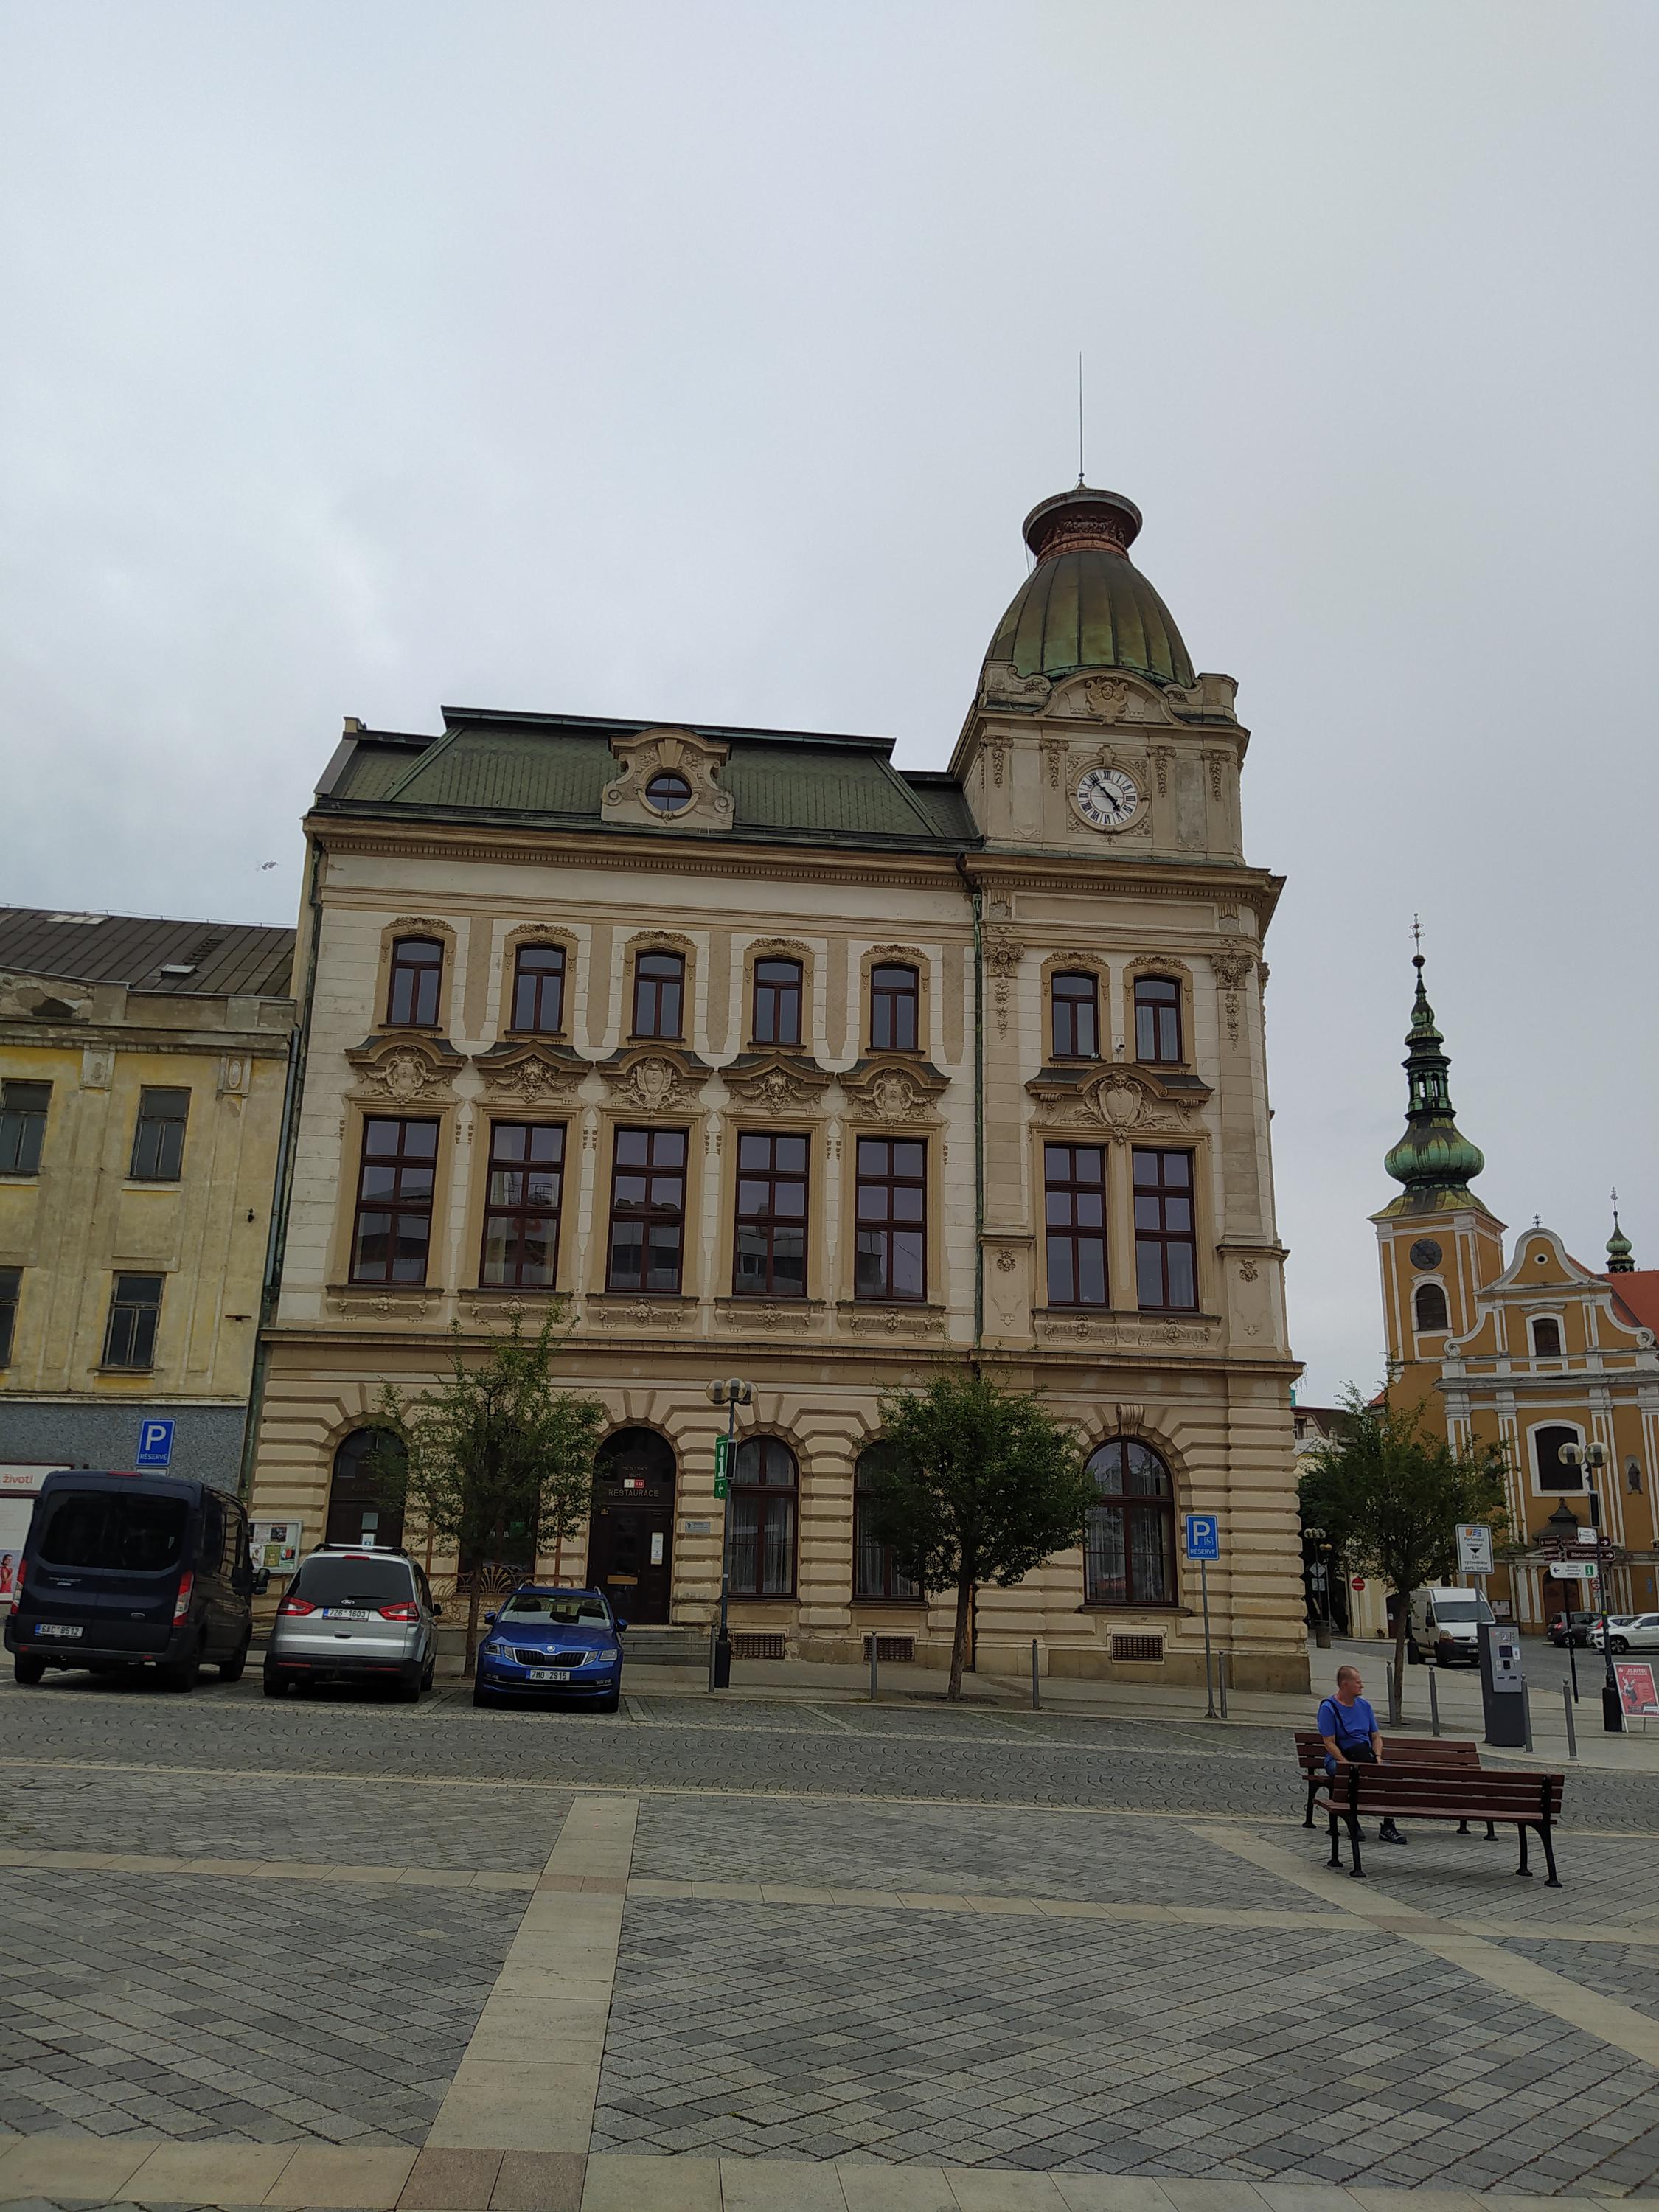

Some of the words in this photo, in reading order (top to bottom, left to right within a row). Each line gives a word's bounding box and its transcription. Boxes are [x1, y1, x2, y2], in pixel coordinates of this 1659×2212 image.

[1103, 771, 1111, 780] XII
[1116, 775, 1121, 784] I
[1081, 780, 1092, 789] X
[1116, 812, 1124, 822] V
[145, 1425, 167, 1451] P
[3, 1474, 33, 1484] život!
[608, 1489, 659, 1498] RESTAURACE
[1193, 1520, 1211, 1545] P
[532, 1671, 545, 1679] 7M0
[549, 1672, 567, 1680] 2915
